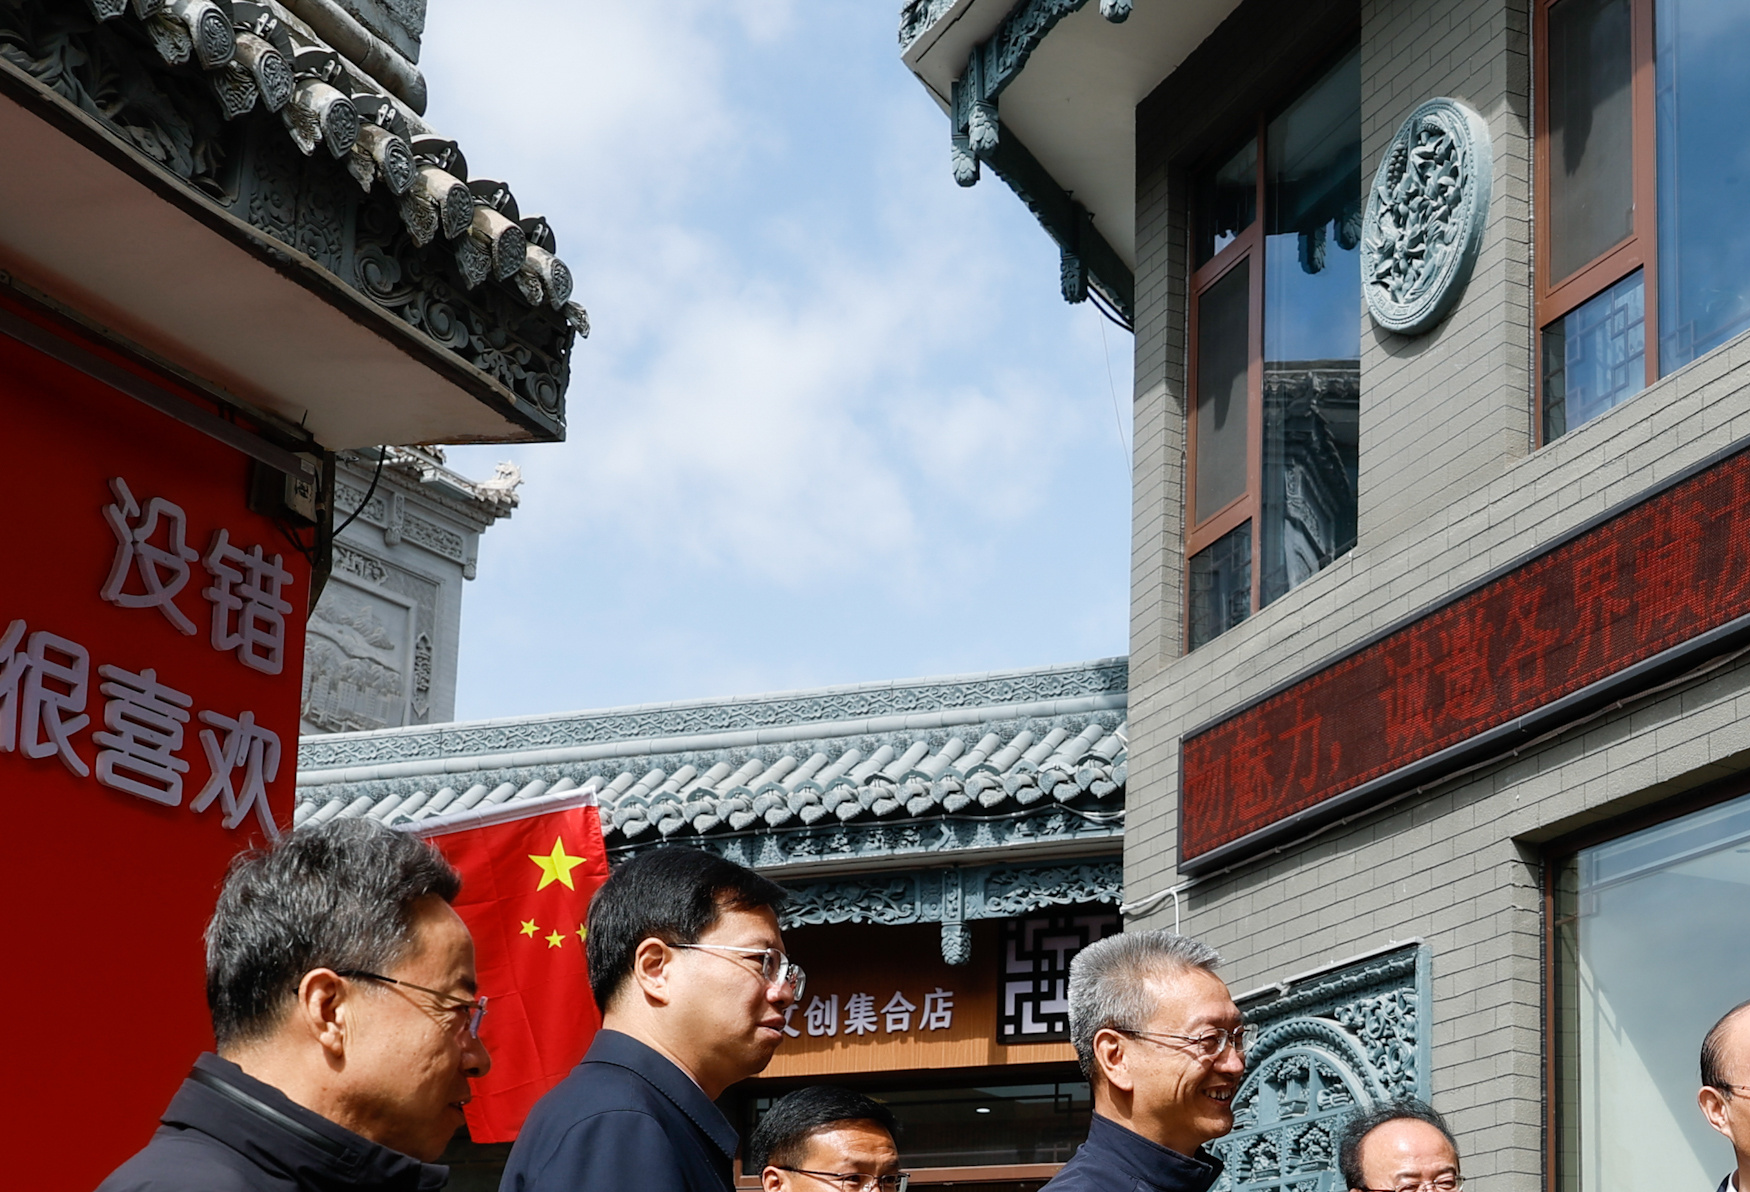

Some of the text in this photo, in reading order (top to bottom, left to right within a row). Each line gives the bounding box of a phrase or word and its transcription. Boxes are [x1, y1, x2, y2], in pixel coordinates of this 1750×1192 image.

[100, 476, 295, 675] 没错
[0, 618, 282, 842] 很喜欢
